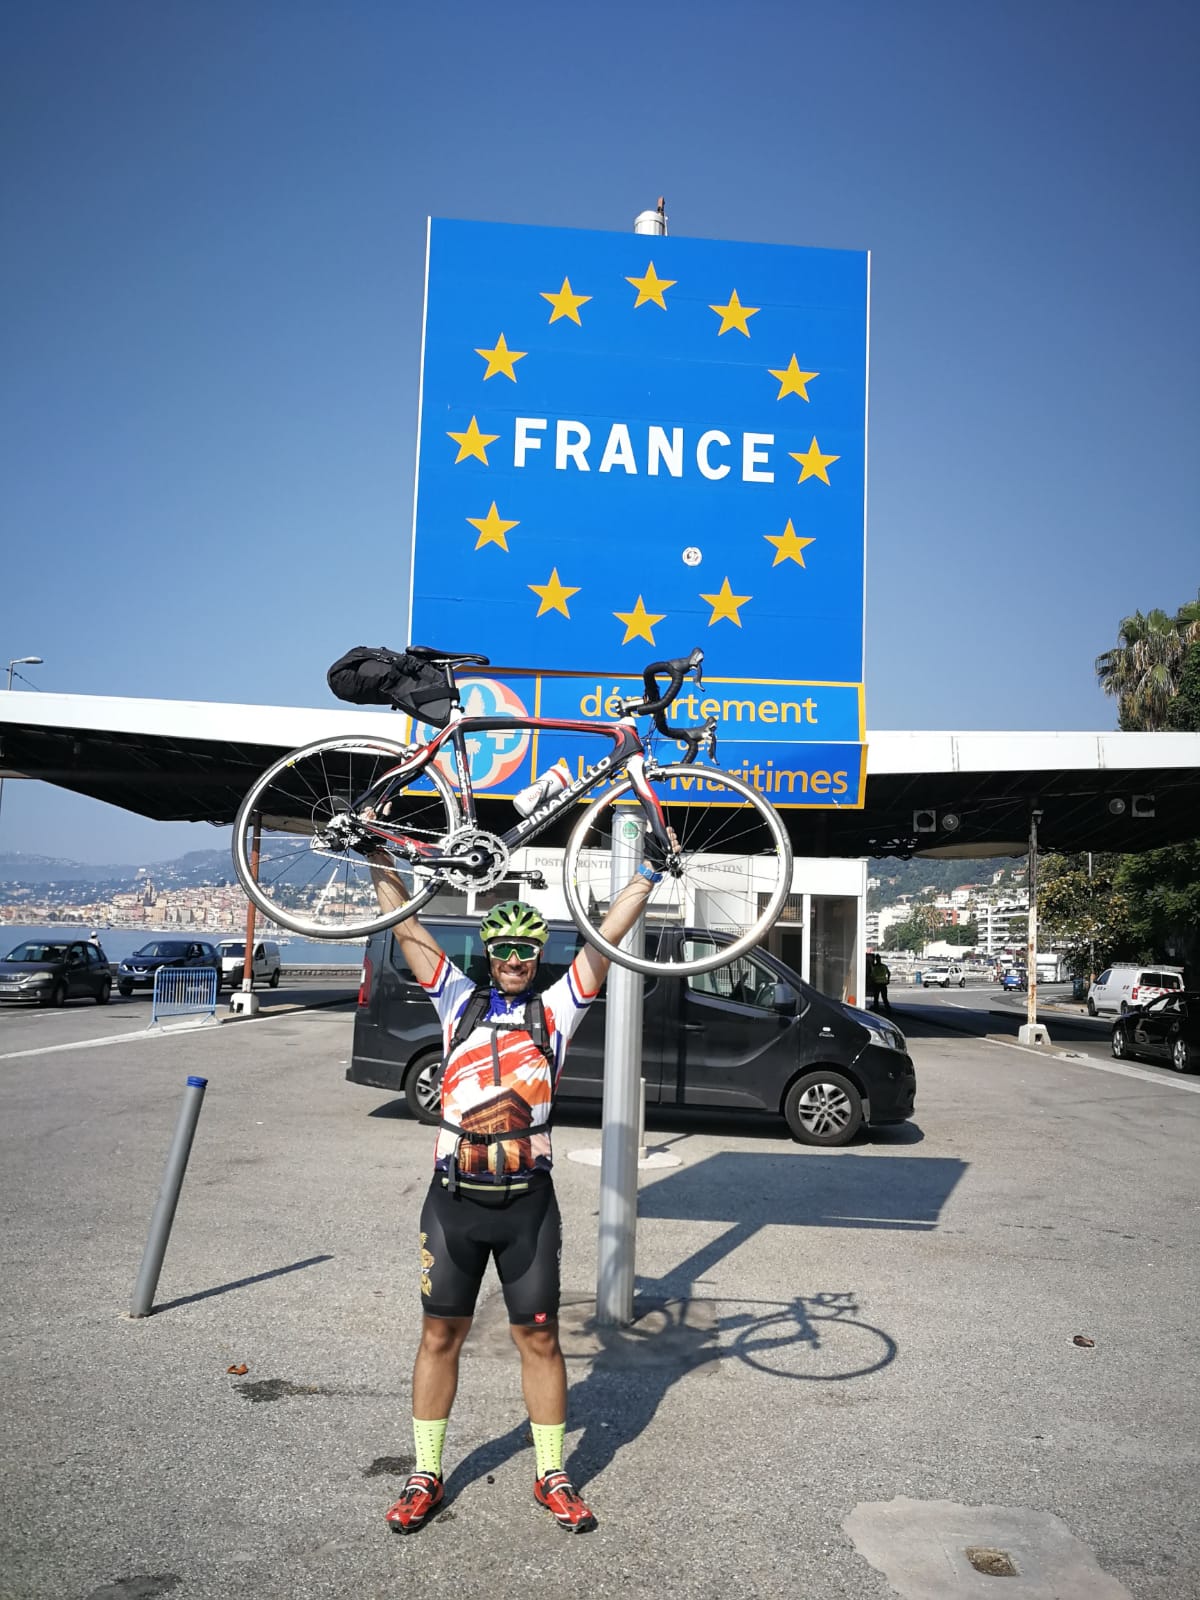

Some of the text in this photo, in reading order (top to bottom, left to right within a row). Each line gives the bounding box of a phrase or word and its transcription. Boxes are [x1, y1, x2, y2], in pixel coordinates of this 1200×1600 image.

[513, 417, 775, 483] FRANCE
[580, 685, 819, 724] dértement
[516, 756, 611, 834] PINARELLO
[535, 857, 563, 867] POST
[697, 864, 743, 873] MENTON
